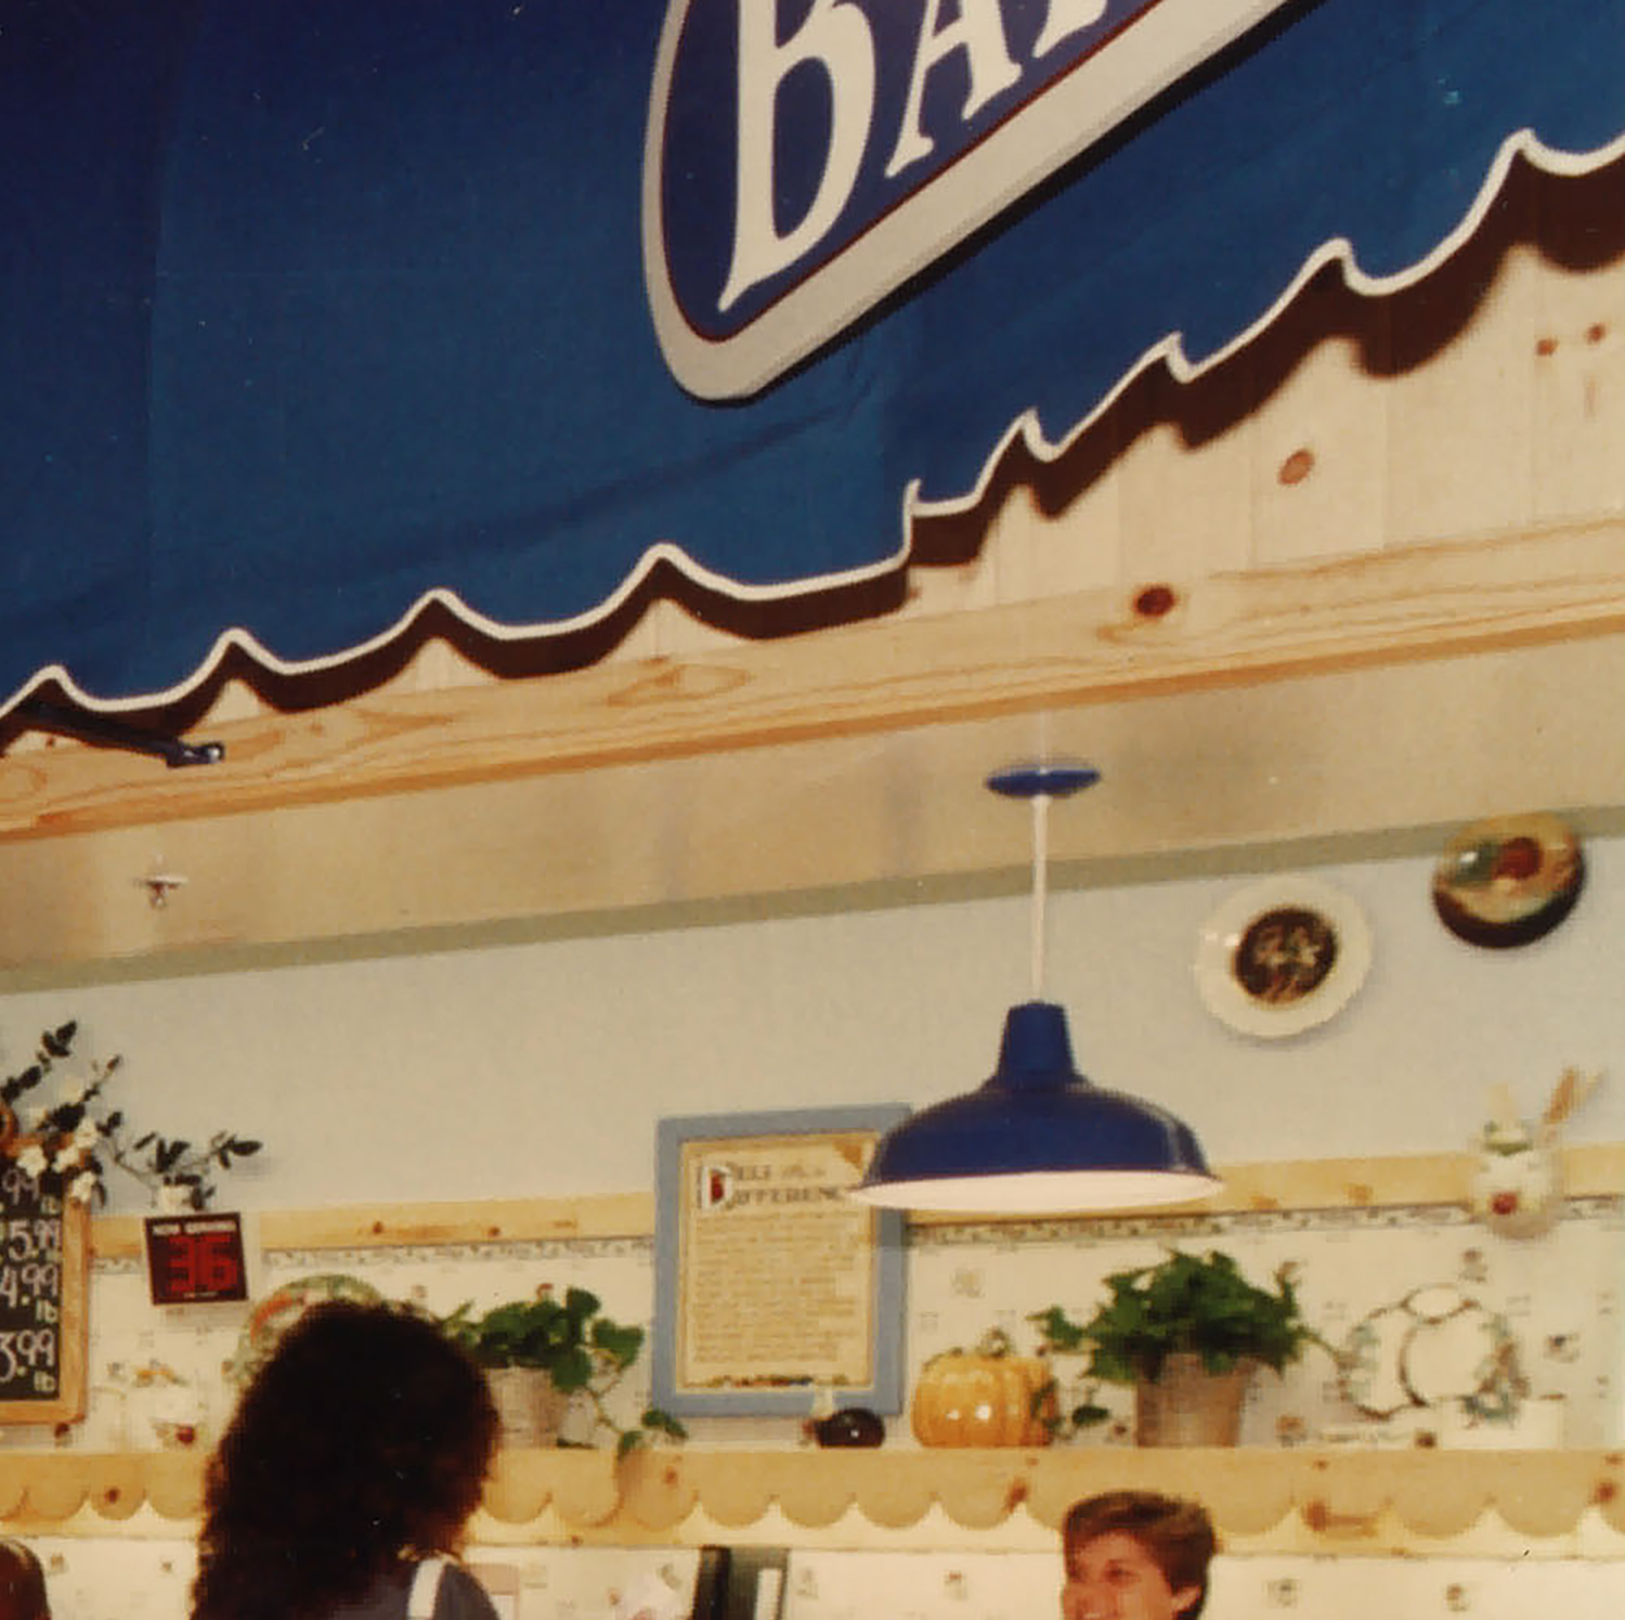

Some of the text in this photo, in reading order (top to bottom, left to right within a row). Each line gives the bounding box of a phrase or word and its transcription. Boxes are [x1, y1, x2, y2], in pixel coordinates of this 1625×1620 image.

[717, 0, 1112, 312] BA
[36, 1299, 58, 1323] lb
[33, 1370, 56, 1392] lb
